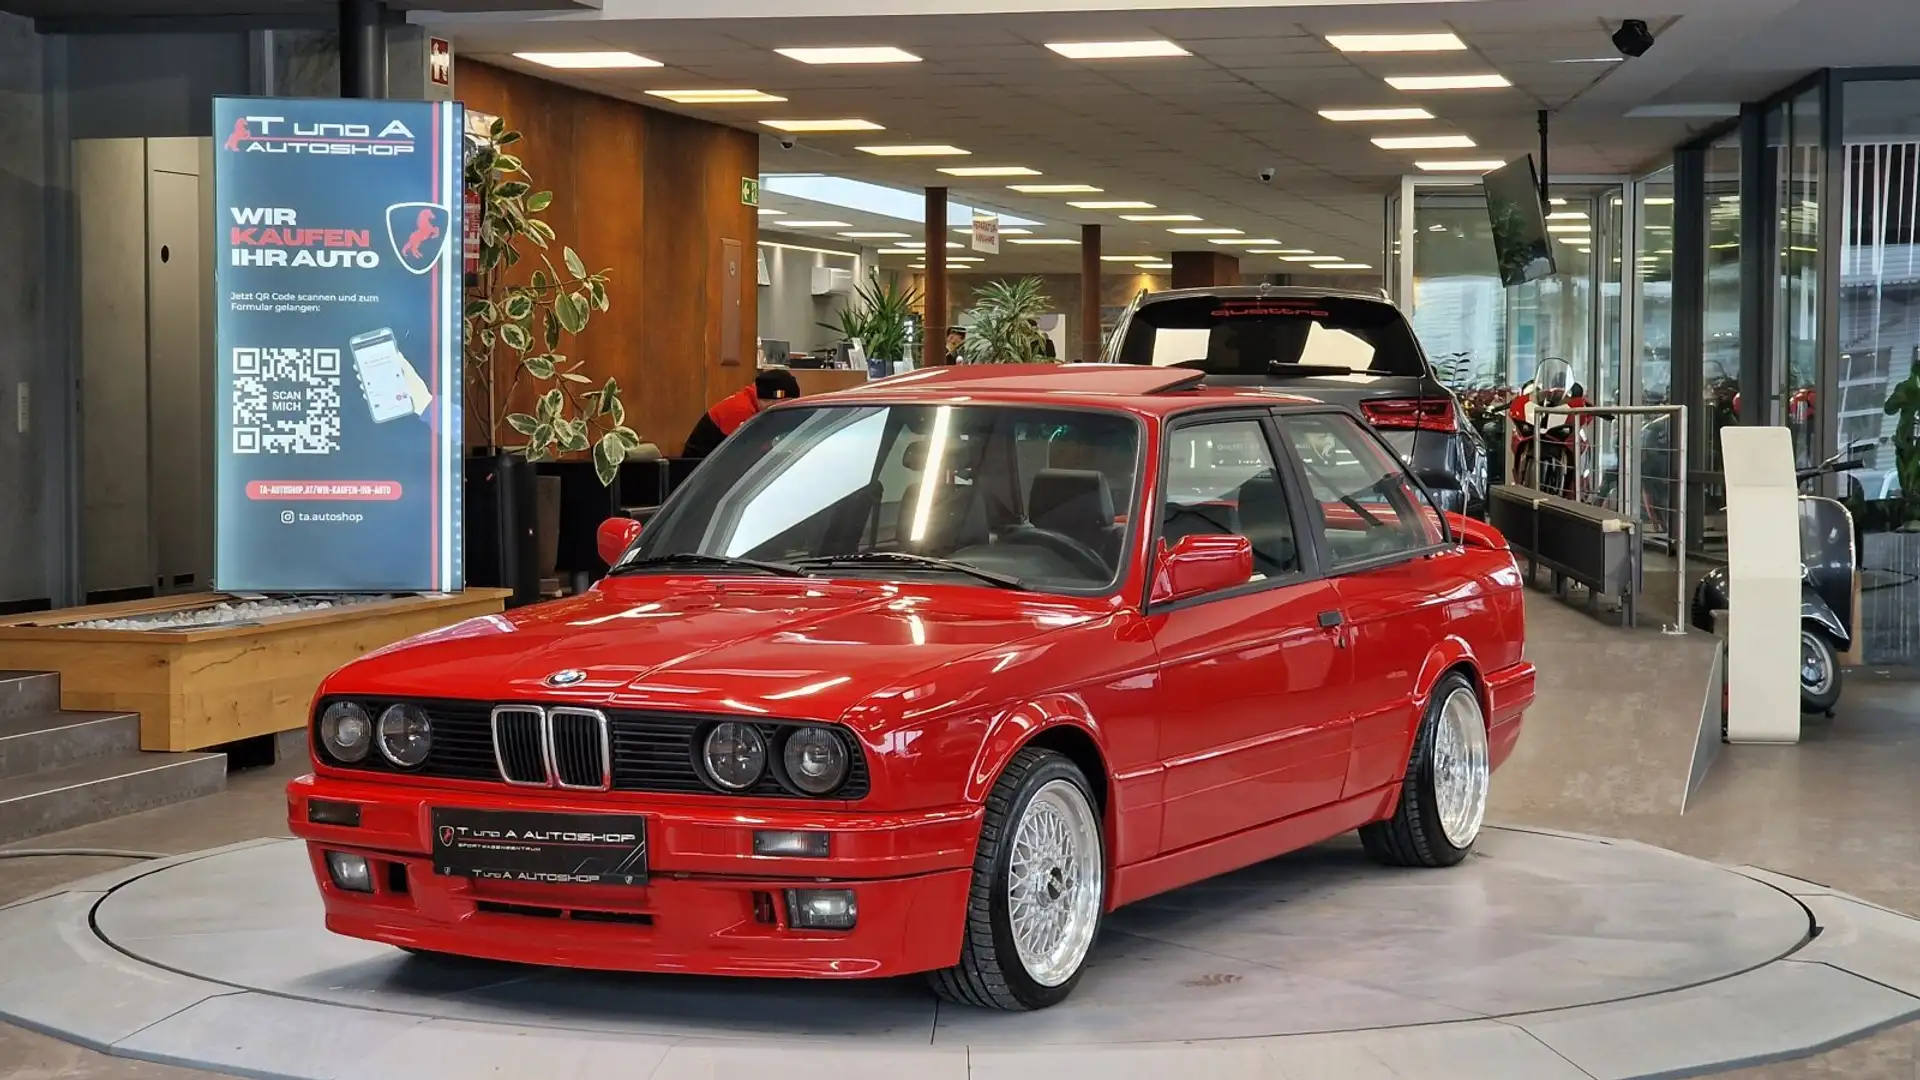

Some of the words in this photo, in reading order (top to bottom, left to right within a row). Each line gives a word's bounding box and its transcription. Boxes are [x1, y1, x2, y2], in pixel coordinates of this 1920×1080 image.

[246, 116, 284, 135] T
[377, 119, 415, 138] A
[246, 141, 414, 156] AUTOSHOP
[230, 207, 297, 226] WIR
[231, 227, 370, 247] KAUFEN
[231, 248, 288, 267] IHR
[290, 249, 380, 269] AUTO
[230, 292, 253, 301] Jetzt
[255, 292, 270, 302] QR
[271, 292, 296, 301] Code
[298, 294, 336, 302] scannen
[338, 293, 357, 302] und
[358, 295, 380, 303] zum
[231, 302, 273, 311] Formular
[274, 302, 320, 313] gelangen:
[1211, 308, 1328, 316] quattro
[272, 391, 301, 400] SCAN
[272, 402, 301, 411] MICH
[299, 512, 363, 523] ta.autoshop
[456, 826, 469, 835] T
[505, 830, 518, 838] A
[523, 831, 635, 843] AUTOSHOP
[472, 869, 482, 877] T
[502, 871, 512, 879] A
[517, 872, 600, 883] AUTOSHOP
